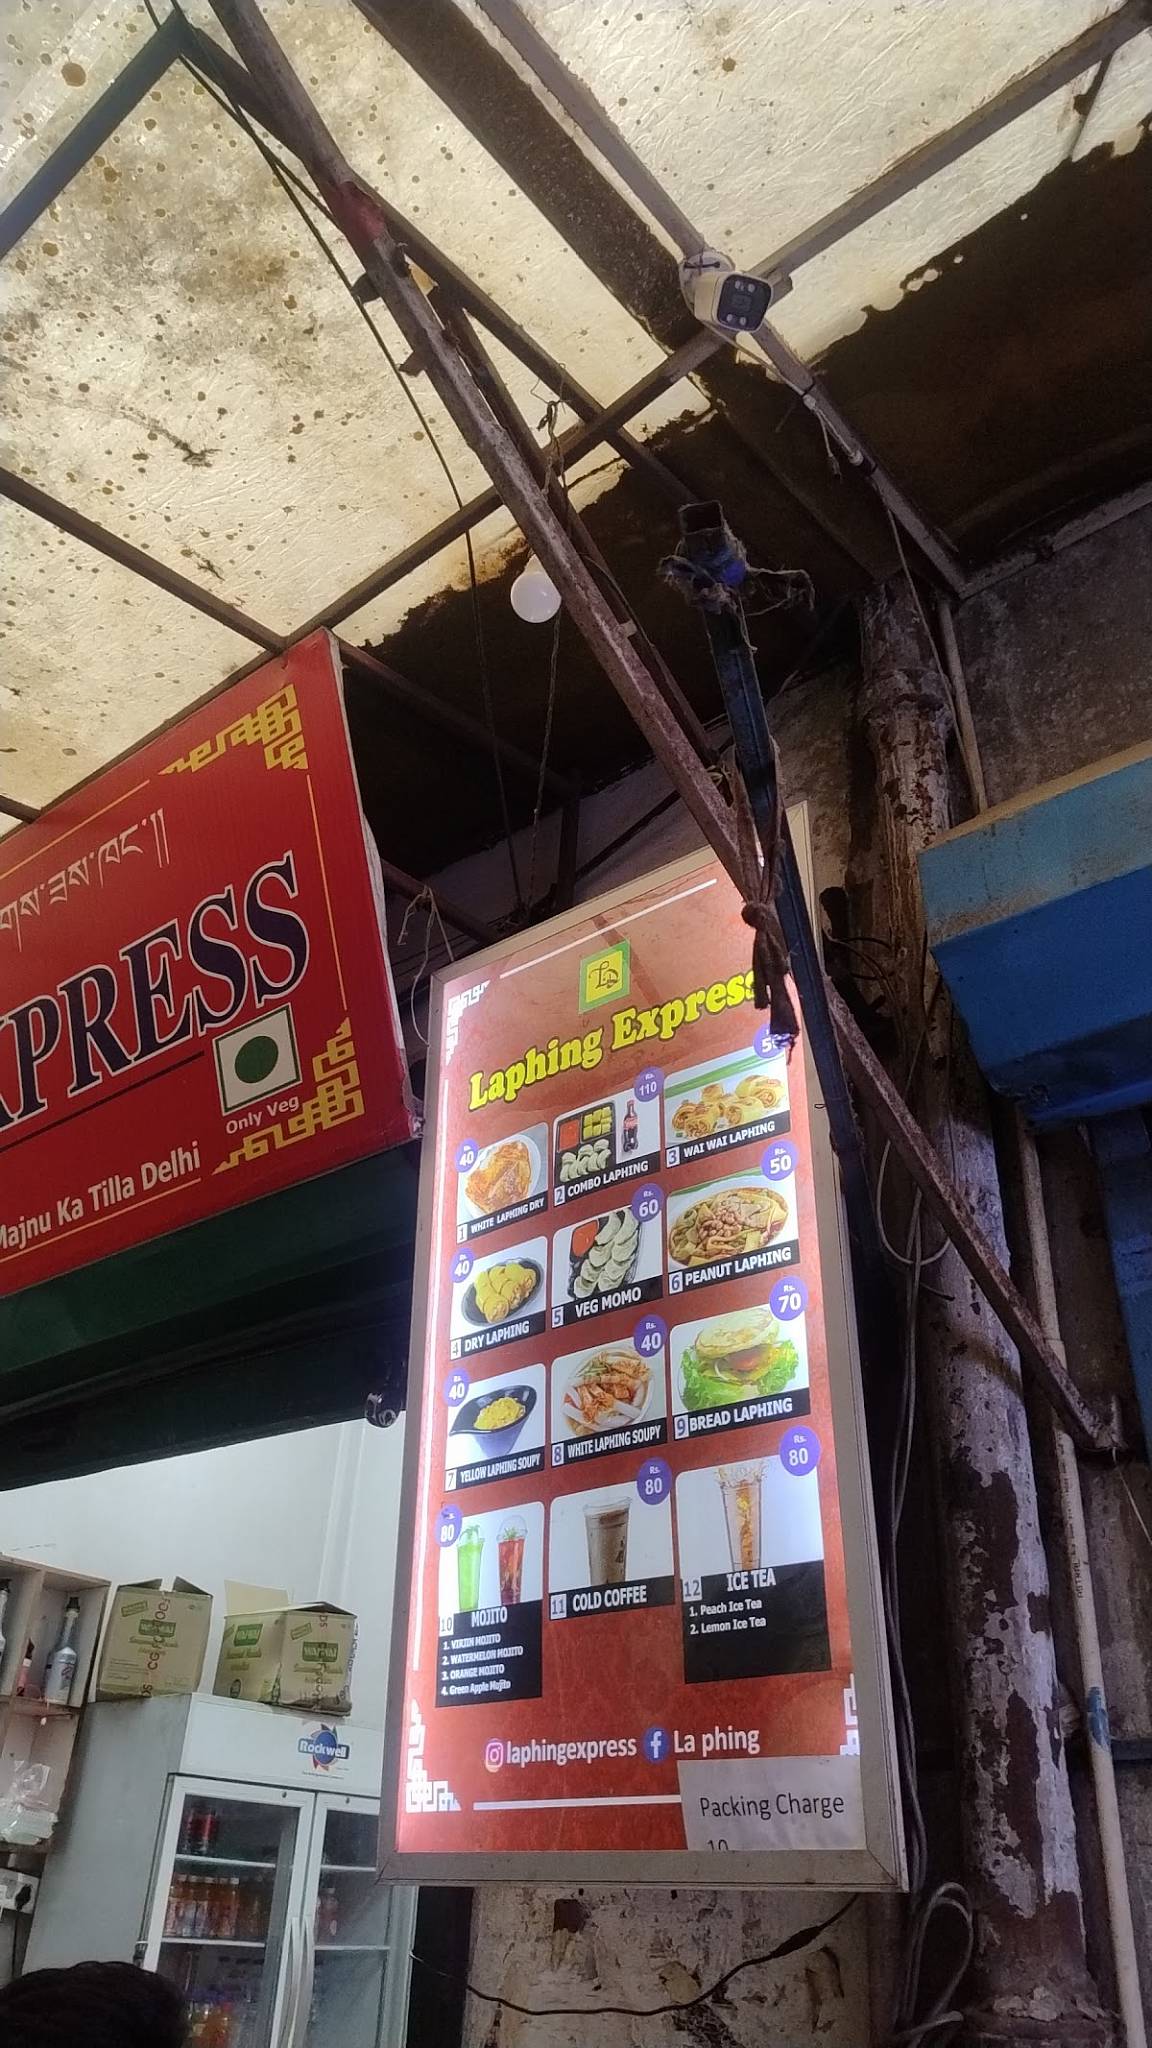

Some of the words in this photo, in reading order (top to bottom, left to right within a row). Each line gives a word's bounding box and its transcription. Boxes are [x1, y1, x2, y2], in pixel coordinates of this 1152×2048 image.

[0, 850, 309, 1132] PRESS
[469, 1027, 603, 1110] Laphing
[639, 1081, 657, 1096] 110
[225, 1111, 262, 1135] Only
[266, 1095, 300, 1118] Veg
[668, 1150, 677, 1165] 3
[683, 1144, 704, 1159] WAI
[706, 1136, 728, 1152] WAI
[729, 1120, 776, 1144] LAPHING
[459, 1150, 474, 1166] 40
[770, 1156, 792, 1175] 50
[57, 1196, 83, 1226] Ka
[88, 1174, 135, 1213] Tilla
[140, 1140, 200, 1190] Delhi
[556, 1188, 564, 1203] 2
[567, 1176, 601, 1198] COMBO
[602, 1160, 649, 1181] LAPHING
[471, 1216, 494, 1234] WHITE
[529, 1197, 545, 1212] DRY
[638, 1199, 659, 1217] 60
[454, 1260, 470, 1278] 40
[672, 1275, 681, 1291] 6
[685, 1262, 732, 1287] PEANUT
[734, 1247, 792, 1273] LAPHING
[553, 1308, 562, 1324] 5
[575, 1299, 599, 1318] VEG
[601, 1286, 642, 1311] MOMO
[778, 1292, 802, 1314] 70
[464, 1334, 485, 1352] DRY
[486, 1321, 530, 1345] LAPHING
[641, 1332, 662, 1352] 40
[448, 1382, 465, 1400] 40
[677, 1417, 687, 1437] 9
[689, 1410, 731, 1432] BREAD
[733, 1397, 793, 1423] LAPHING
[553, 1445, 562, 1463] 8
[567, 1439, 593, 1459] WHITE
[594, 1432, 631, 1453] LAPHING
[631, 1425, 662, 1445] SOUPY
[789, 1447, 809, 1466] 80
[460, 1465, 486, 1484] YELLOW
[487, 1457, 516, 1477] LAPHING
[517, 1453, 541, 1470] SOUPY
[645, 1477, 663, 1495] 80
[440, 1523, 455, 1543] 80
[684, 1579, 701, 1598] 12
[726, 1570, 750, 1592] ICE
[750, 1567, 777, 1588] TEA
[552, 1600, 566, 1615] 11
[572, 1590, 601, 1612] COLD
[604, 1585, 648, 1608] COFFEE
[700, 1601, 727, 1616] Peach
[729, 1600, 744, 1612] Ice
[747, 1598, 763, 1610] Tea
[471, 1606, 508, 1628] MOJITO
[701, 1619, 731, 1634] Lemon
[733, 1618, 748, 1630] Ice
[749, 1616, 767, 1628] Tea
[450, 1649, 496, 1665] WATERMELON
[497, 1645, 523, 1658] MOJITO
[450, 1667, 477, 1680] ORANGE
[479, 1664, 504, 1676] MOJITO
[449, 1684, 469, 1696] Green
[470, 1681, 489, 1696] Apple
[299, 1739, 347, 1758] Rockwell
[507, 1736, 637, 1768] laphingexpress
[673, 1729, 696, 1754] La
[702, 1726, 760, 1758] phing
[700, 1795, 772, 1821] Packing
[776, 1792, 845, 1820] Charge
